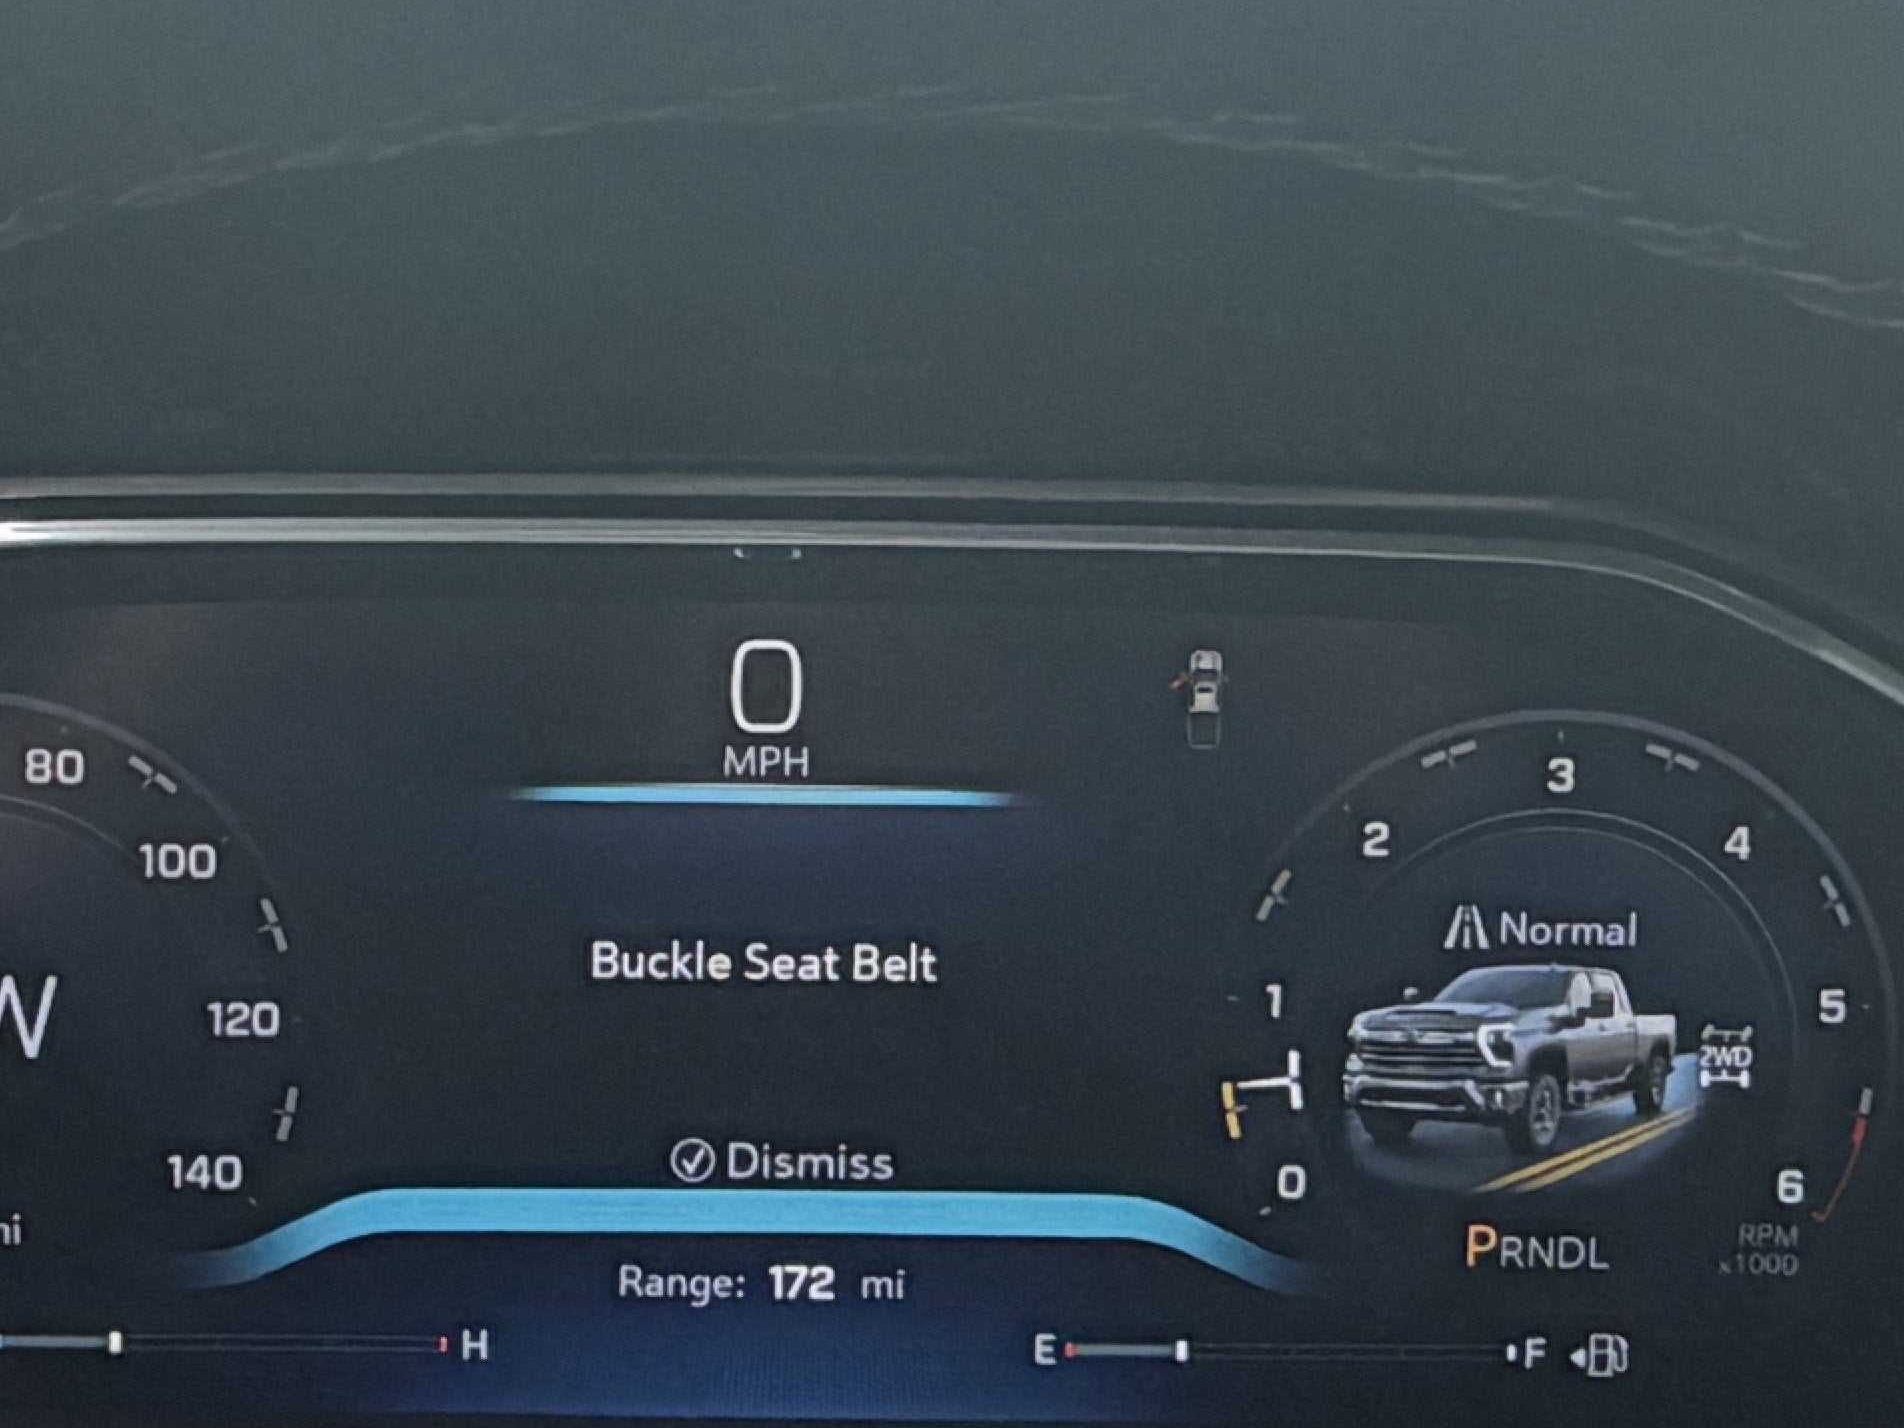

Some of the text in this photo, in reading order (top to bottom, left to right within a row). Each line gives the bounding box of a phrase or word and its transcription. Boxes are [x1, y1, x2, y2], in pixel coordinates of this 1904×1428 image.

[731, 639, 801, 733] 0
[26, 749, 83, 783] 80
[725, 746, 808, 777] MPH
[1548, 759, 1575, 792] 3
[1363, 823, 1389, 856] 2
[1725, 827, 1751, 859] 4
[140, 844, 215, 879] 100
[1501, 911, 1637, 945] Normal
[593, 940, 937, 981] Buckle Seat Belt
[1267, 985, 1281, 1017] 1
[1820, 989, 1845, 1023] 5
[208, 1003, 279, 1036] 120
[1700, 1045, 1752, 1067] 2WD
[169, 1155, 241, 1189] 140
[729, 1143, 893, 1179] Dismiss
[1279, 1165, 1305, 1199] 0
[1779, 1170, 1803, 1203] 6
[1739, 1223, 1797, 1247] RPM
[619, 1265, 905, 1307] Range: 172 mi
[463, 1329, 487, 1359] H
[1035, 1334, 1057, 1365] E
[1525, 1338, 1545, 1368] F
